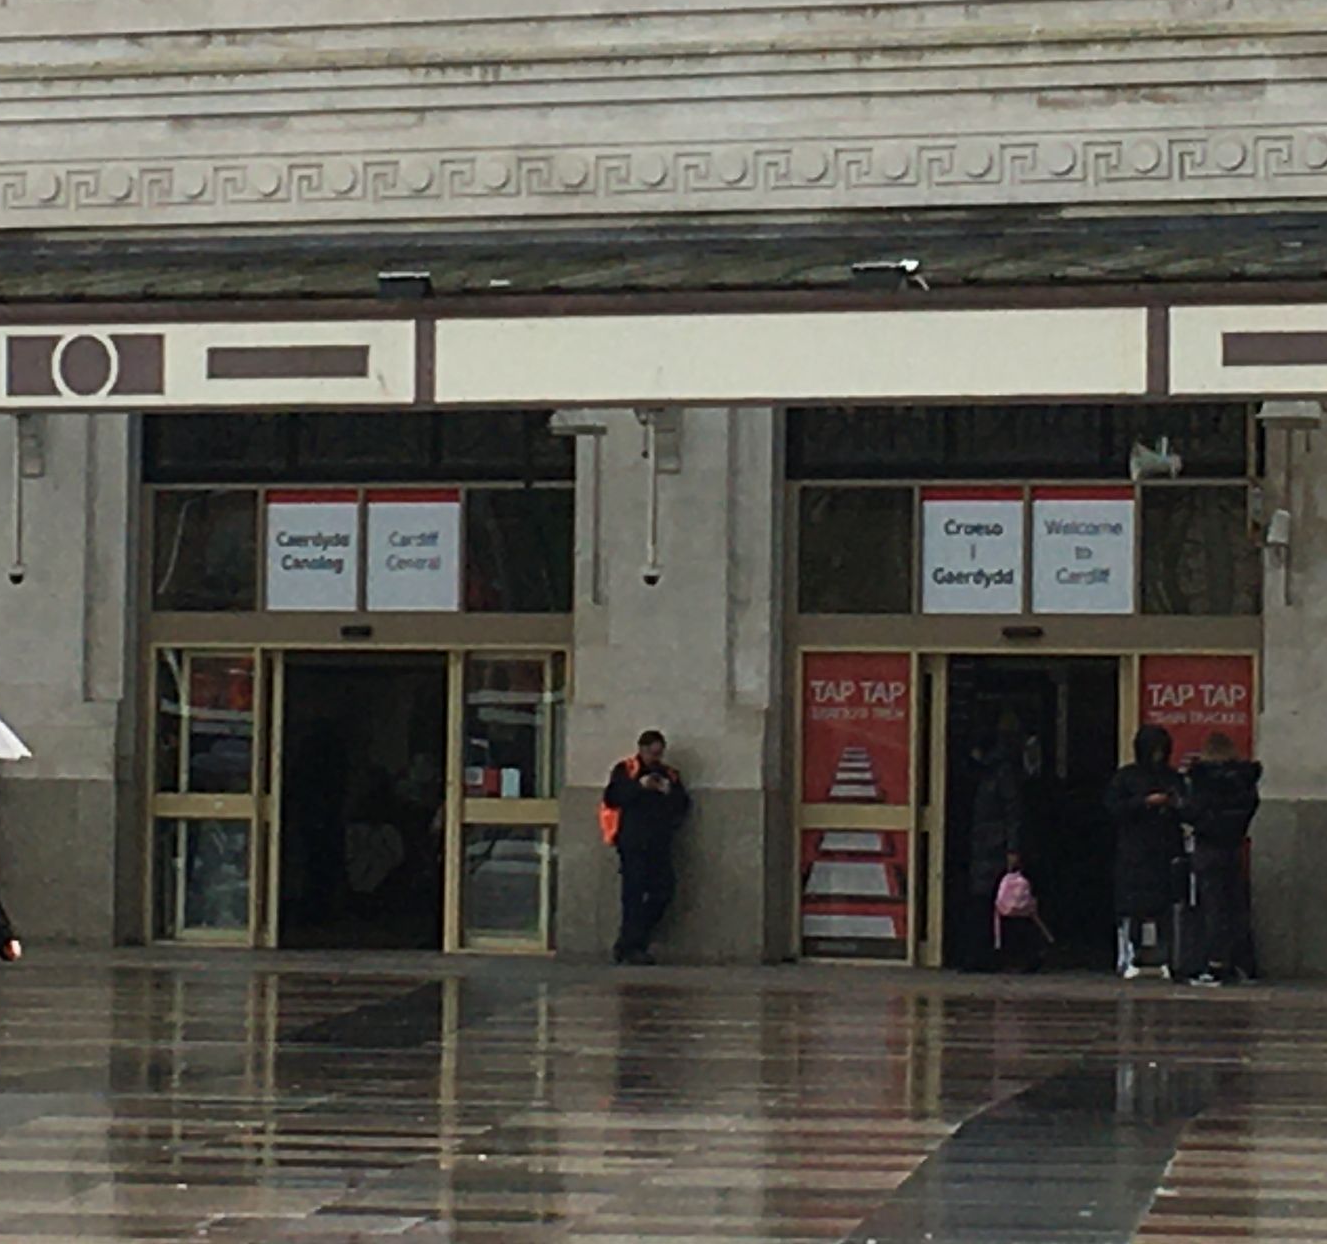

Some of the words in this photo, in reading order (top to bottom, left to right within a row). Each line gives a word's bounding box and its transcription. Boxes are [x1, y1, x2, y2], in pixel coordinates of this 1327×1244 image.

[943, 519, 1004, 536] Croeso
[1043, 519, 1124, 536] Welcome
[1055, 567, 1111, 585] Cardiff
[810, 679, 856, 703] TAP
[859, 680, 907, 704] TAP
[1147, 683, 1195, 707] TAP
[1199, 683, 1247, 708] TAP
